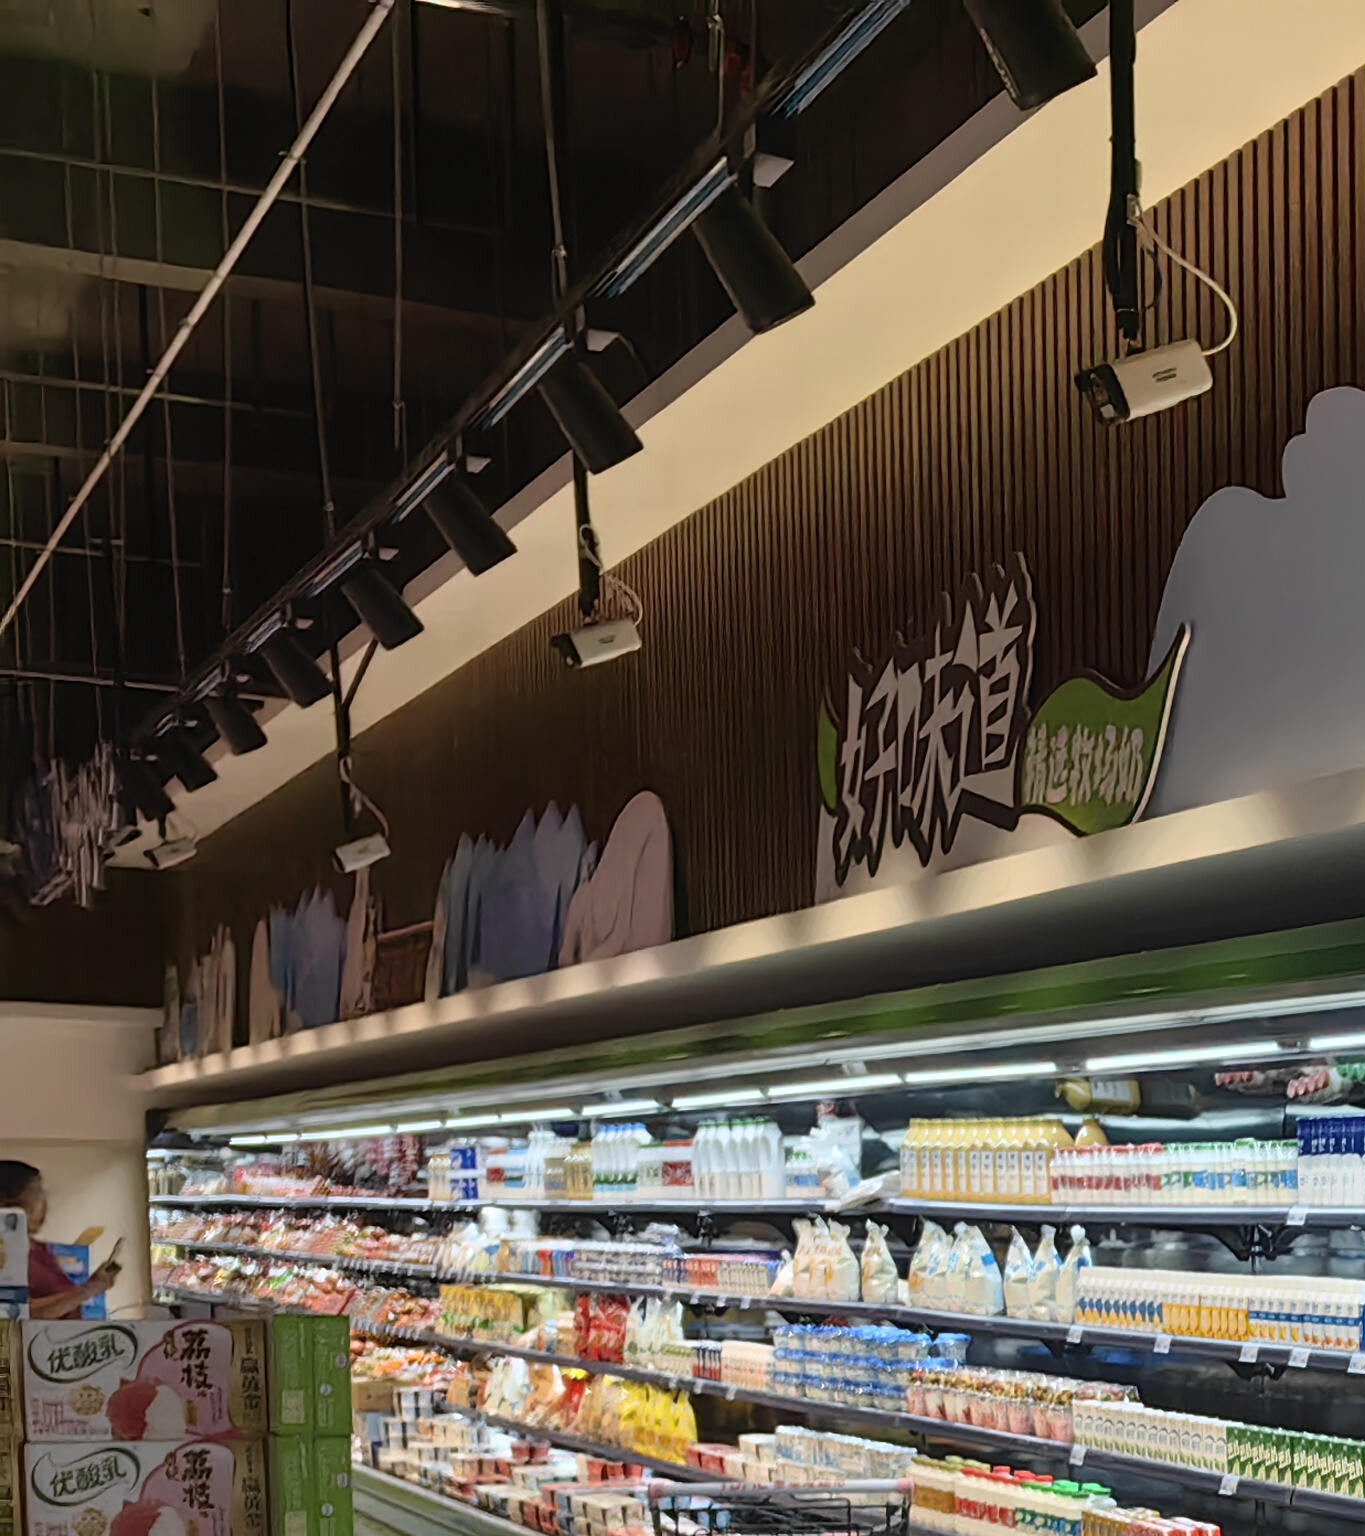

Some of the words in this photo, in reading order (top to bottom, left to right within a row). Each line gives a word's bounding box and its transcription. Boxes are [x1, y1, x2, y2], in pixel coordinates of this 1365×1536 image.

[839, 580, 1024, 865] 好味道
[47, 1333, 125, 1374] 优酸乳
[180, 1328, 213, 1389] 荔枝
[50, 1456, 127, 1497] 优酸乳
[182, 1449, 215, 1509] 荔枝
